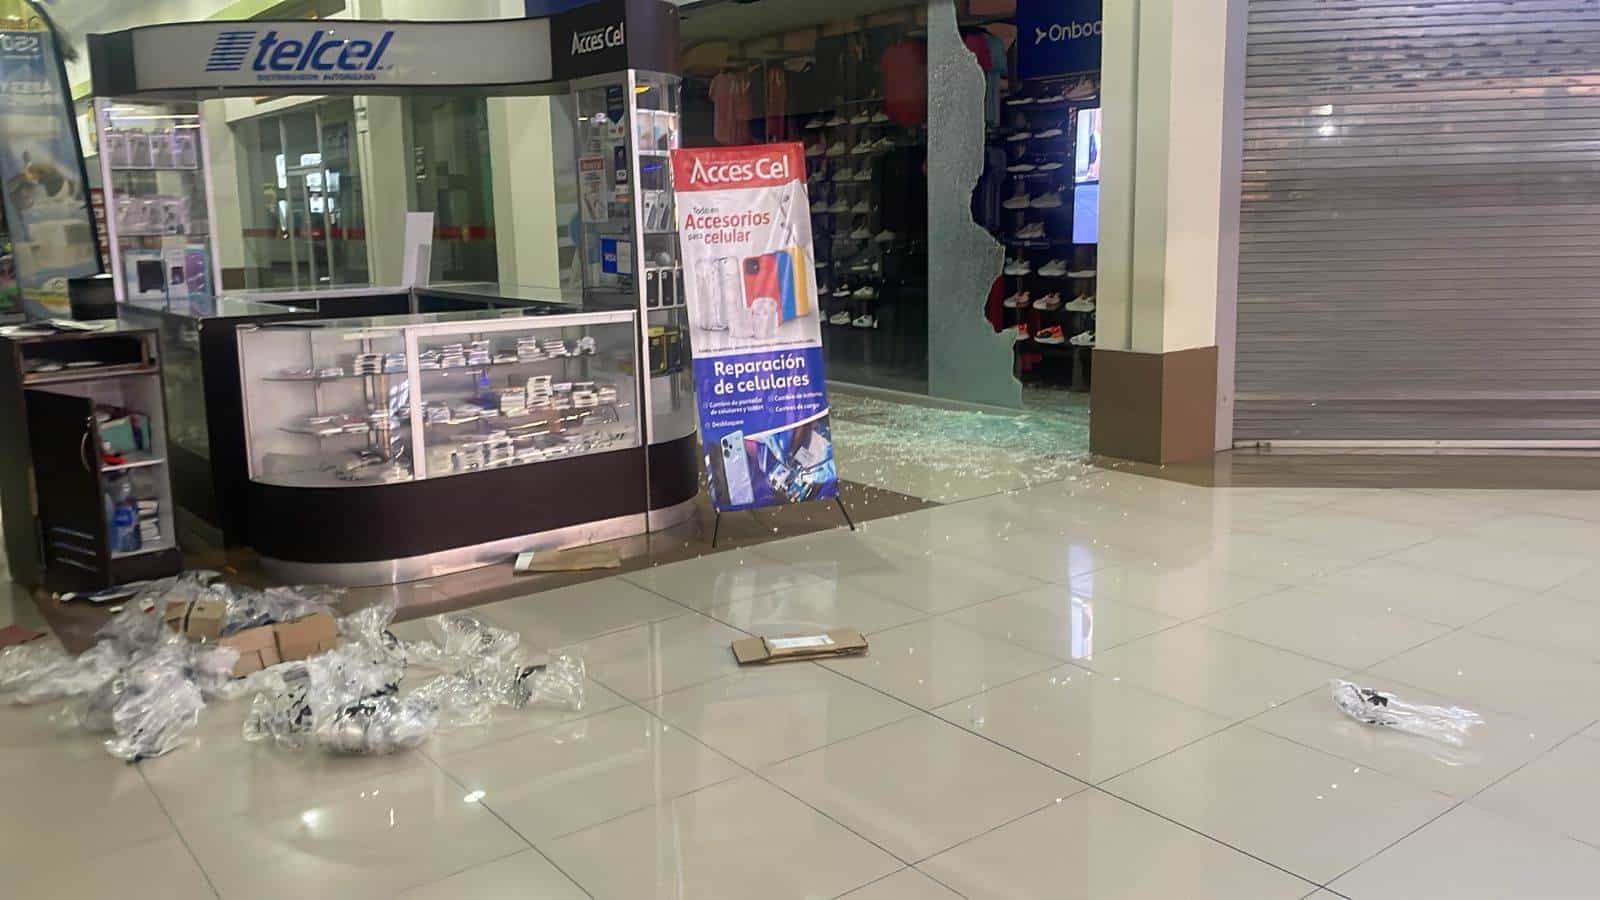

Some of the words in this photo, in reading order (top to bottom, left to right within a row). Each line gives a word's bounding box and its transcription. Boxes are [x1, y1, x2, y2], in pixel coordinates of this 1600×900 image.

[252, 30, 394, 71] telcel
[571, 32, 604, 56] Acces
[605, 21, 624, 47] Cel
[690, 156, 753, 184] Acces
[755, 154, 789, 179] Cel
[685, 210, 770, 230] Accesorios
[704, 229, 751, 244] celular
[714, 353, 805, 378] Reparación
[714, 378, 734, 395] de
[737, 373, 810, 393] celulares
